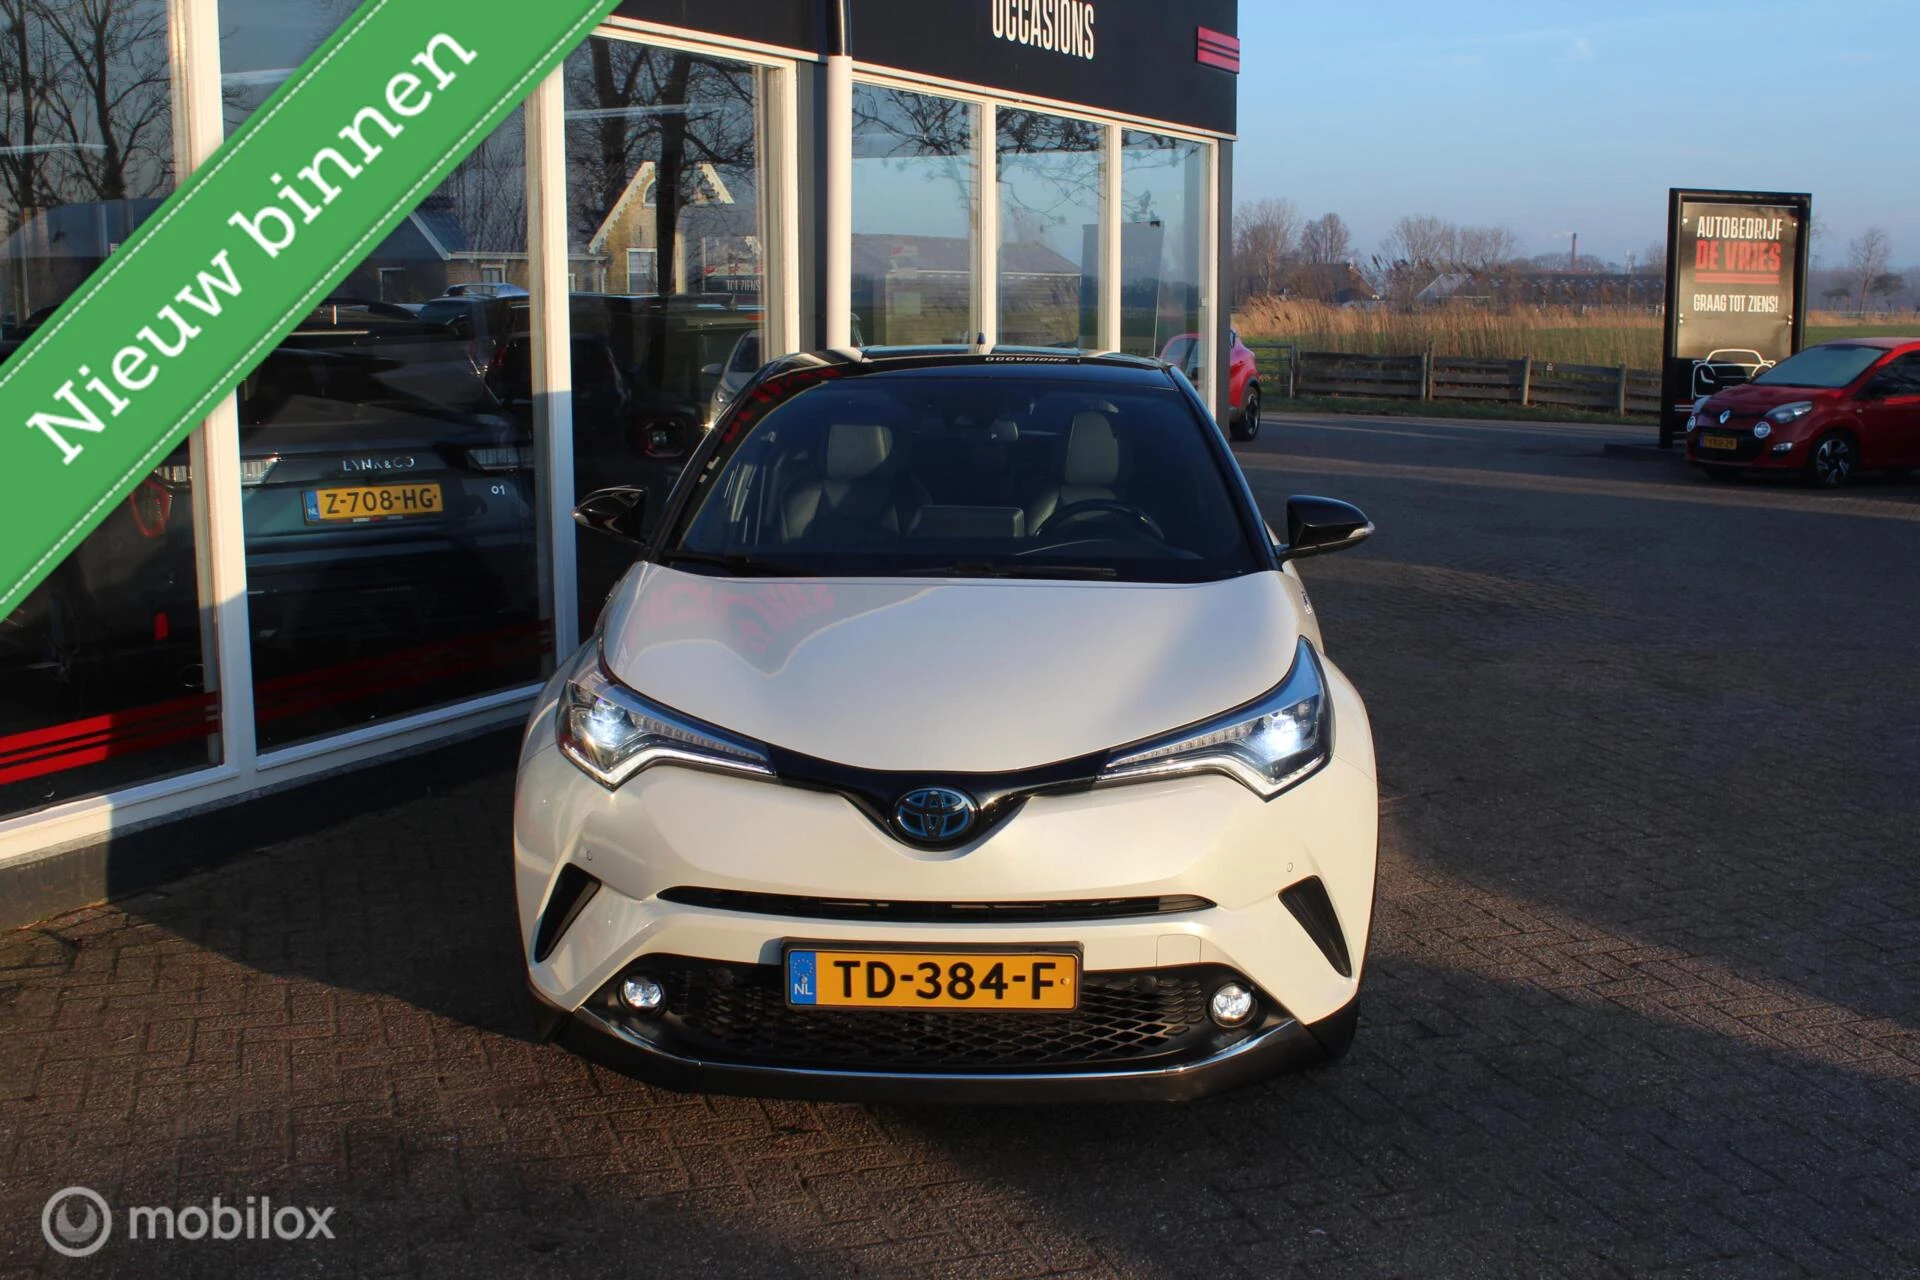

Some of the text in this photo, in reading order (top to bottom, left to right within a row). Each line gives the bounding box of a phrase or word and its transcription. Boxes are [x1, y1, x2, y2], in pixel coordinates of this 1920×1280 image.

[992, 0, 1095, 60] OCCASIONS
[1696, 215, 1783, 240] AUTOBEDRIJF
[1695, 239, 1782, 272] DE VRIES
[1693, 293, 1779, 313] GRAAG TOT ZIENS!
[325, 487, 435, 514] Z-708-HG
[793, 983, 814, 997] NL
[832, 959, 1057, 1001] TD-384-F
